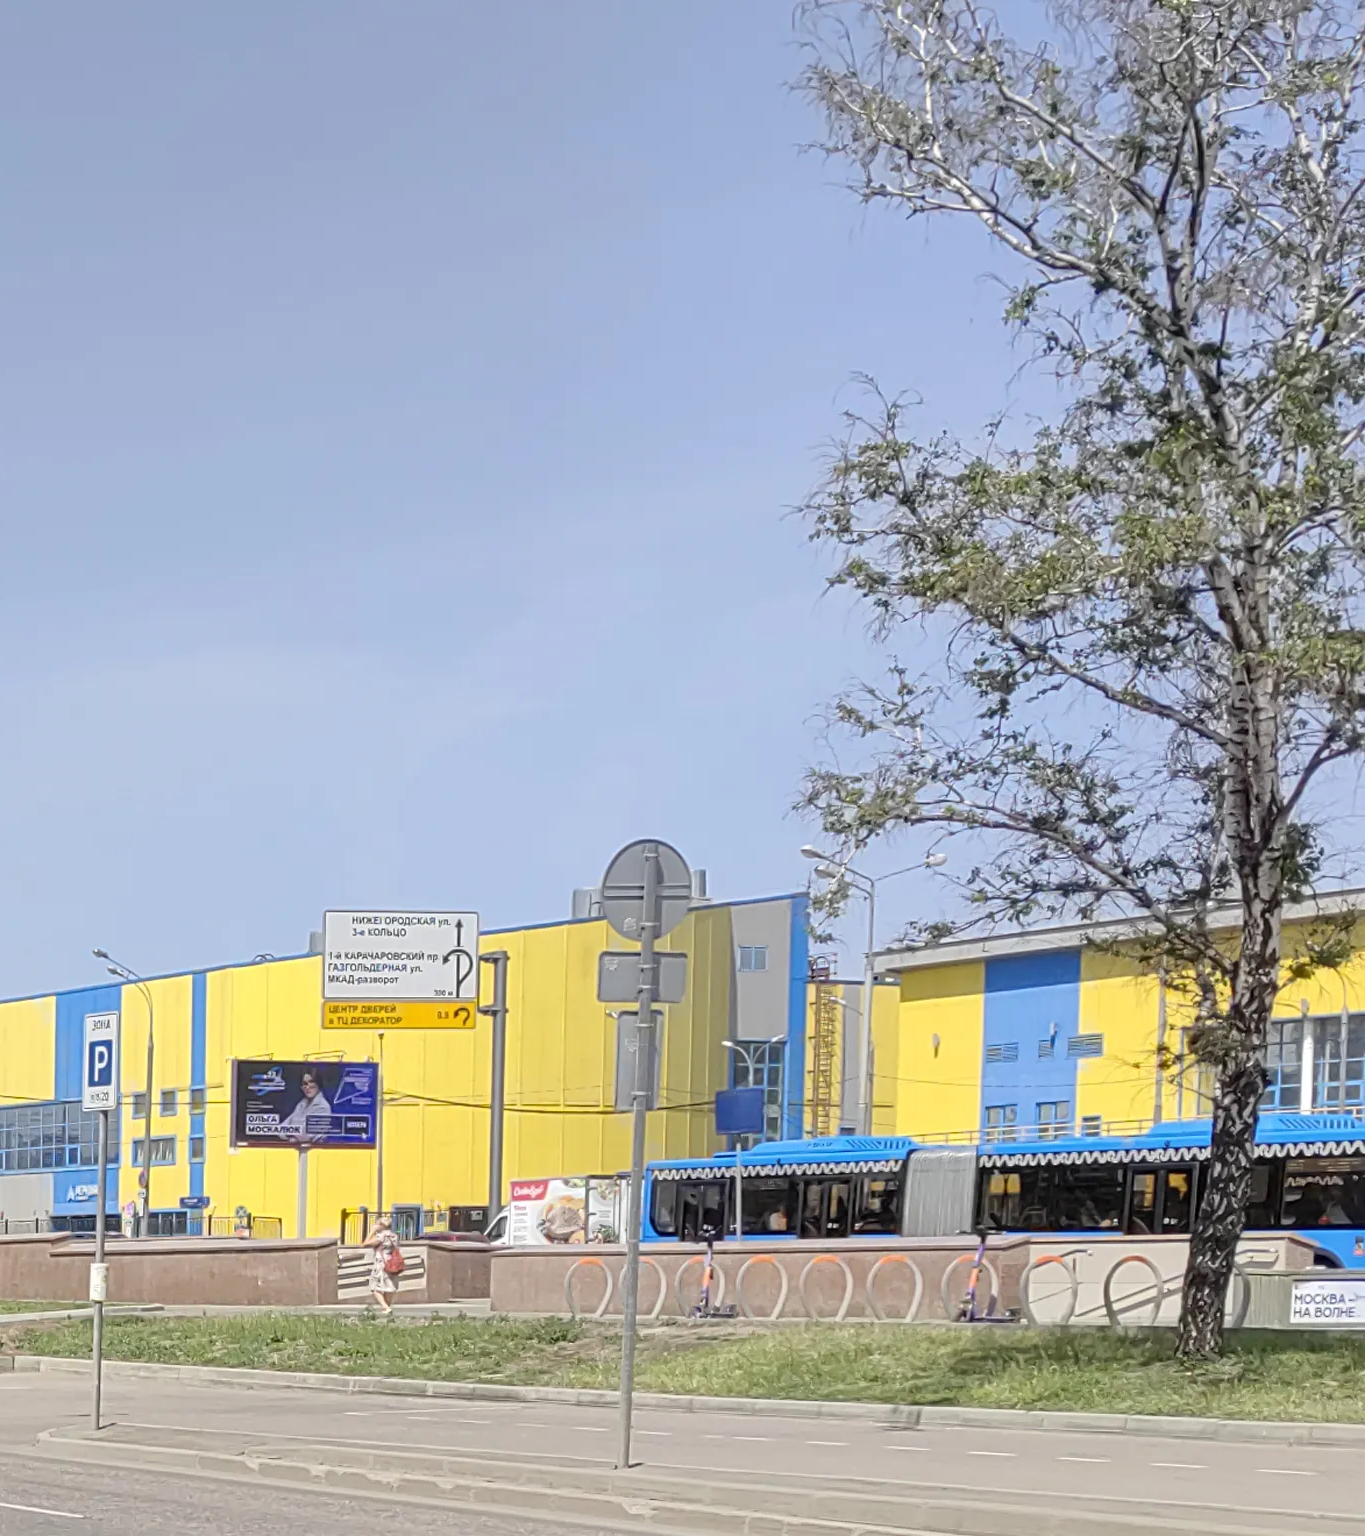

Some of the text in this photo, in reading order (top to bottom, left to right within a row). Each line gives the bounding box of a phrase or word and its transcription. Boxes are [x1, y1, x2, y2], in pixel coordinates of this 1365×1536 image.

[351, 916, 451, 927] НИЖЕГОРОДСКАЯ ул.
[368, 928, 407, 937] КОЛЬЦО
[344, 951, 425, 961] КАРАЧАРОВСКИЙ
[328, 963, 423, 974] ГАЗГОЛЬДЕРНАЯ ул.
[328, 975, 399, 985] МКАД-разворот
[1294, 1293, 1346, 1305] МОСКВА
[1294, 1307, 1311, 1318] НА
